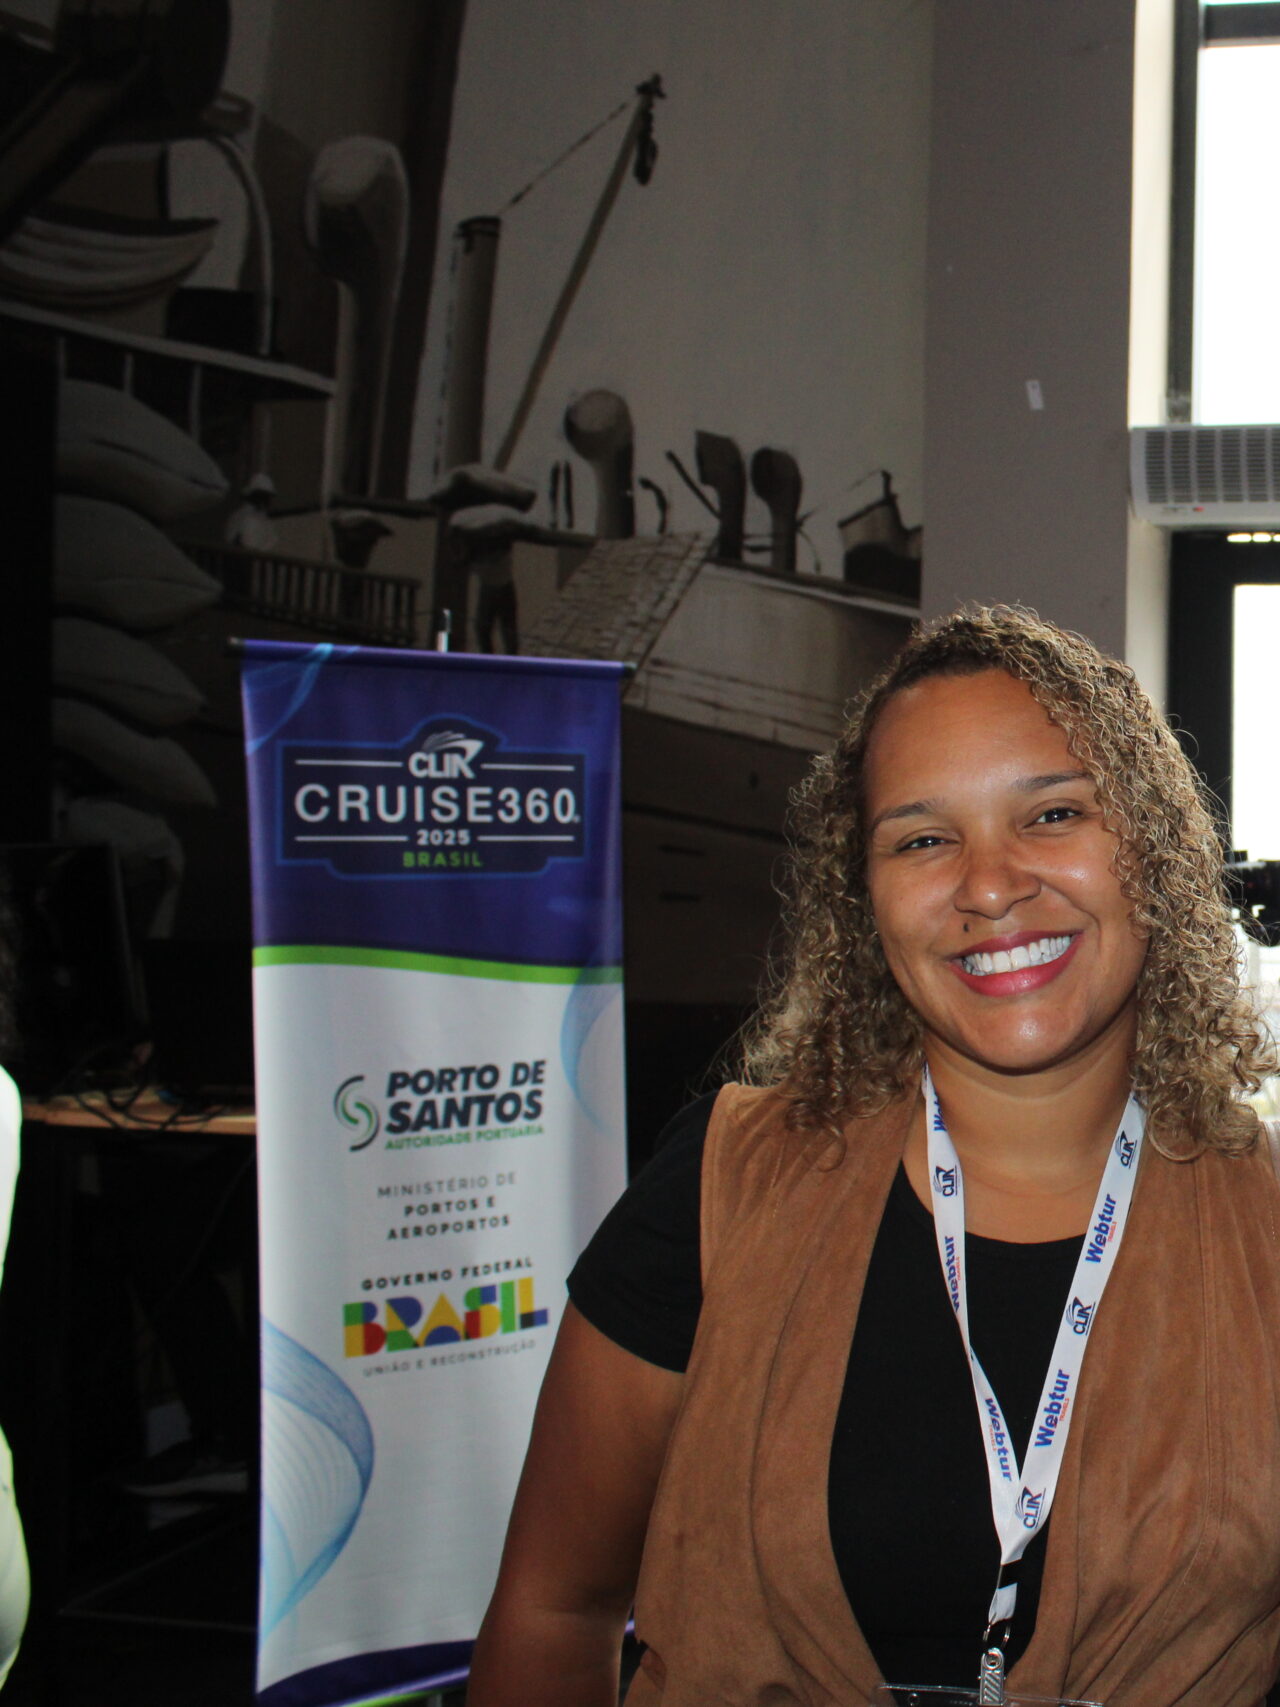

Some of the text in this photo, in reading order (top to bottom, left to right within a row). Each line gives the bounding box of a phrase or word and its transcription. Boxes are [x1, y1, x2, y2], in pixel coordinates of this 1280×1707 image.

[295, 784, 575, 824] CRUISE360
[416, 829, 471, 846] 2025
[402, 851, 483, 867] BRASIL
[386, 1059, 547, 1098] PORTO DE
[384, 1089, 544, 1135] SANTOS
[384, 1131, 472, 1151] AUTORIDADE
[377, 1171, 517, 1199] MINISTÉRIO DE
[404, 1196, 496, 1217] PORTOS E
[387, 1215, 511, 1240] AEROPORTOS
[1085, 1193, 1117, 1264] Webtur
[361, 1257, 533, 1291] GOVERNO FEDERAL
[342, 1276, 549, 1359] BRASIL
[363, 1361, 411, 1378] UNIÃO
[416, 1358, 424, 1370] E
[1034, 1368, 1070, 1449] Webtur
[984, 1397, 1012, 1482] Webtur
